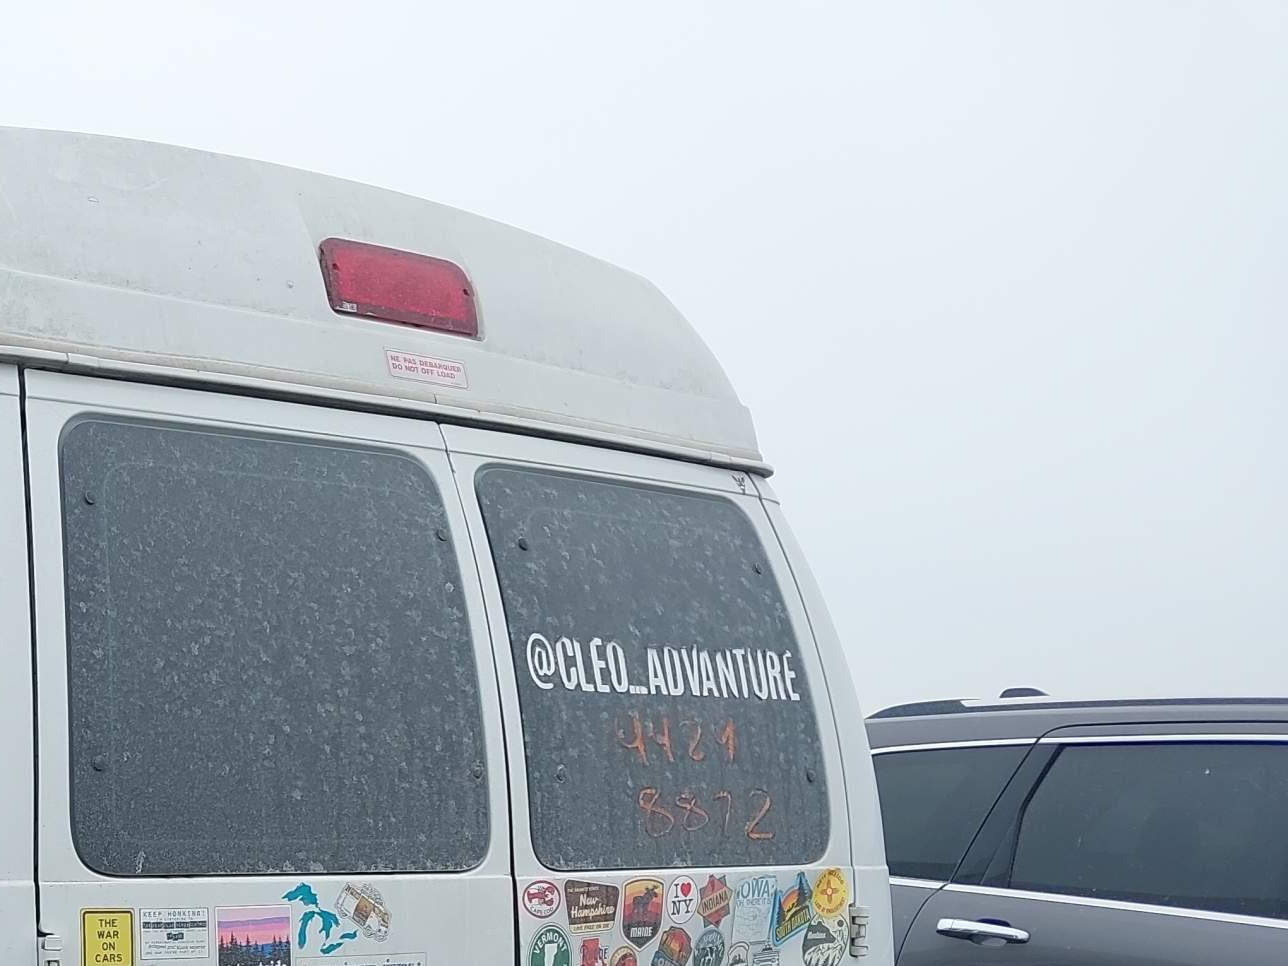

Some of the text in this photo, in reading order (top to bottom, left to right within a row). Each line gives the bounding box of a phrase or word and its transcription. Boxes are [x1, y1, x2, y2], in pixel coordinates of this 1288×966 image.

[405, 364, 419, 372] NOT
[421, 367, 434, 376] OFF
[526, 632, 800, 701] @CLEO_ADVANTURE
[674, 883, 680, 898] I
[579, 894, 600, 906] New
[702, 889, 728, 913] INDIANA
[571, 903, 615, 919] Hampshire
[671, 899, 694, 915] NY
[98, 919, 118, 928] THE
[97, 931, 119, 939] WAR
[630, 927, 653, 937] MAINE
[102, 942, 115, 951] ON
[533, 931, 567, 954] VERMONT
[95, 954, 122, 963] CARS
